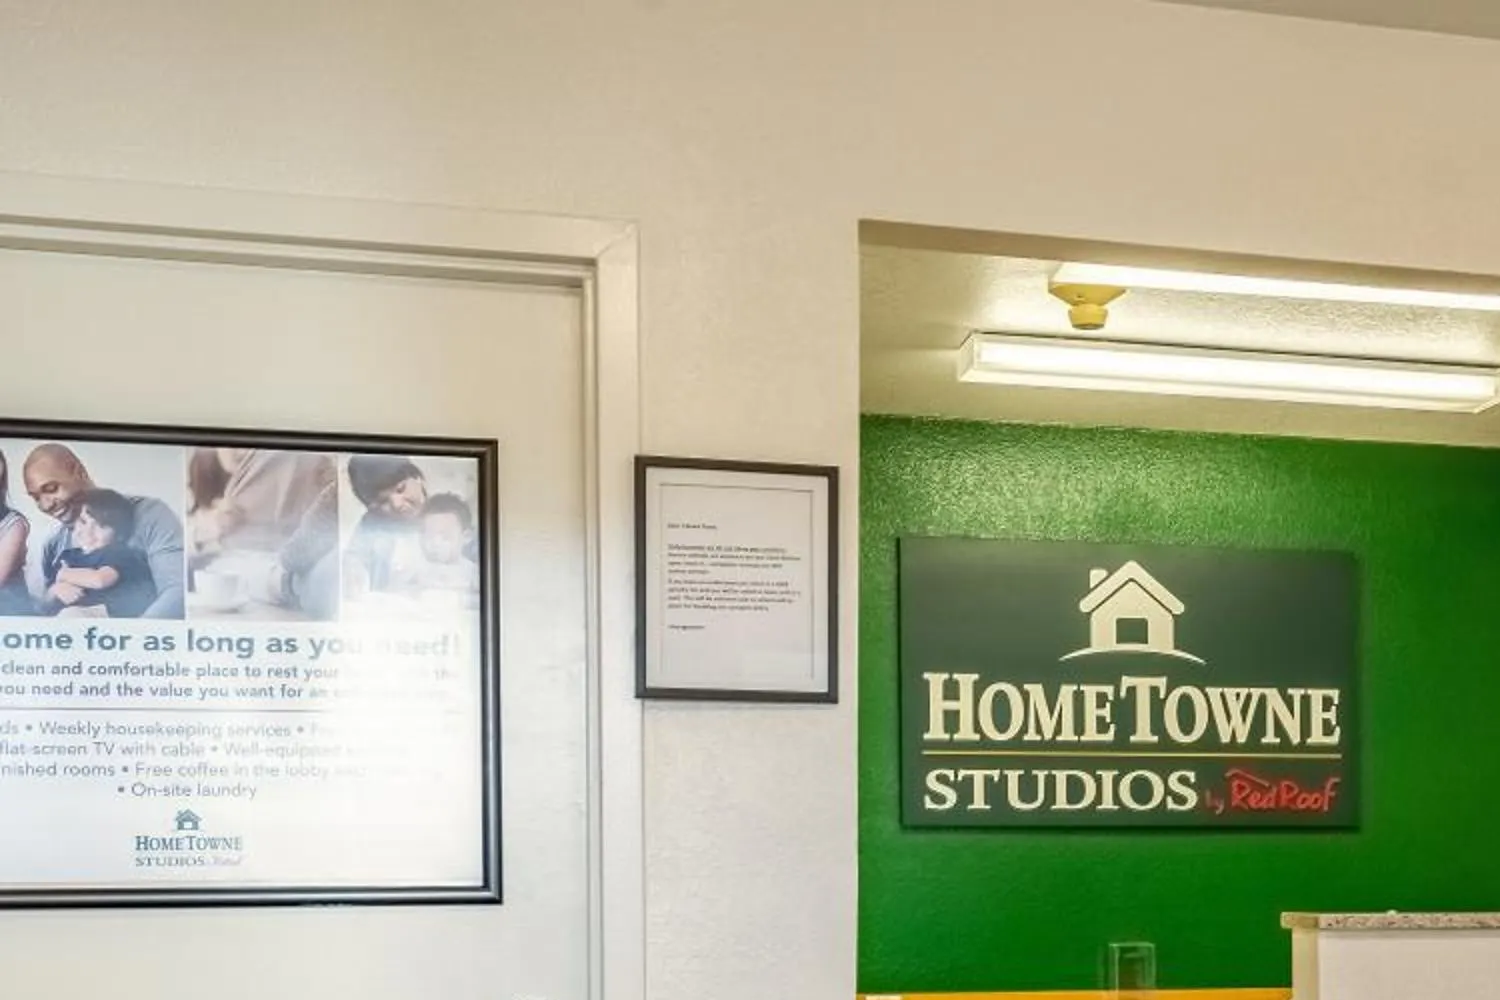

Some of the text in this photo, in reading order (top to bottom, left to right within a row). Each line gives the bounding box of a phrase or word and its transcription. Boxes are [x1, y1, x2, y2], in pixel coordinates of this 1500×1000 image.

[84, 626, 132, 651] for
[143, 635, 176, 652] as
[188, 628, 254, 659] long
[266, 637, 298, 653] as
[308, 637, 361, 660] you
[1, 660, 45, 675] clean
[51, 661, 83, 675] and
[88, 661, 190, 677] comfortable
[196, 663, 238, 680] place
[245, 666, 261, 677] to
[267, 666, 297, 678] rest
[303, 668, 338, 682] your
[31, 681, 73, 696] need
[79, 682, 110, 697] and
[117, 682, 143, 697] the
[150, 683, 193, 697] value
[200, 686, 228, 700] you
[235, 685, 275, 698] want
[281, 684, 304, 698] for
[39, 720, 100, 739] Weekly
[105, 721, 222, 740] housekeeping
[227, 724, 291, 738] services
[92, 742, 115, 755] TV
[121, 742, 156, 756] with
[161, 741, 204, 757] cable
[1, 761, 57, 777] nished
[63, 764, 115, 777] rooms
[135, 761, 172, 776] Free
[177, 762, 228, 778] coffee
[253, 764, 279, 777] the
[131, 782, 256, 800] On-site laundry
[924, 769, 1199, 812] STUDIOS
[1205, 789, 1225, 815] by
[135, 856, 205, 867] STUDIOS
